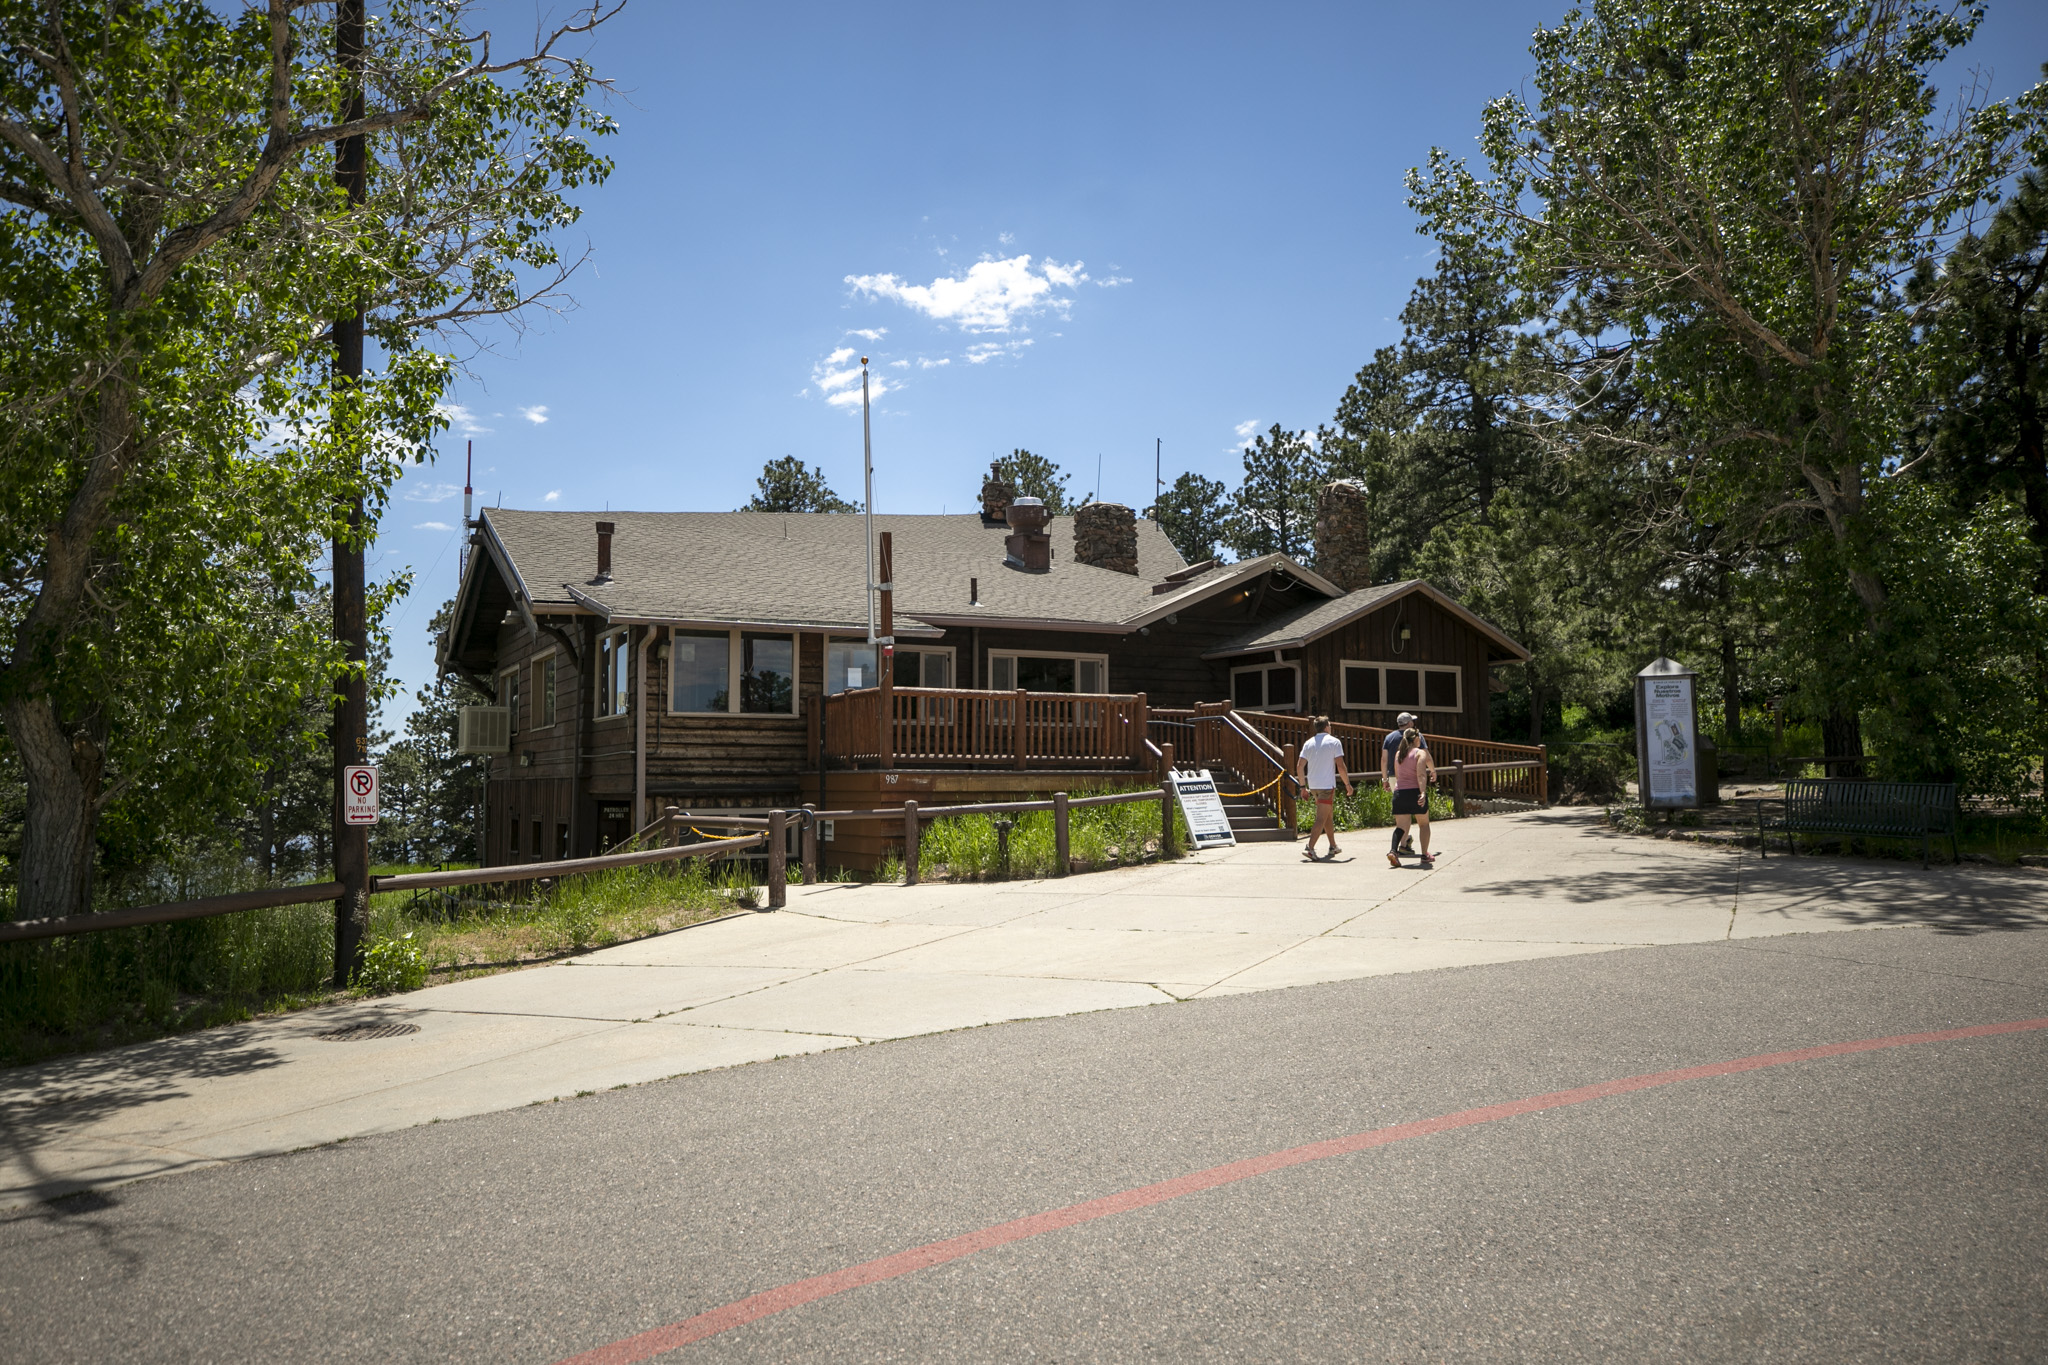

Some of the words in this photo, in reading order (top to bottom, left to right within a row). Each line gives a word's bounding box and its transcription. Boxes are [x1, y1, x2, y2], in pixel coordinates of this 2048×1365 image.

[885, 774, 899, 784] 987
[357, 796, 367, 804] NO
[348, 805, 376, 814] PARKING
